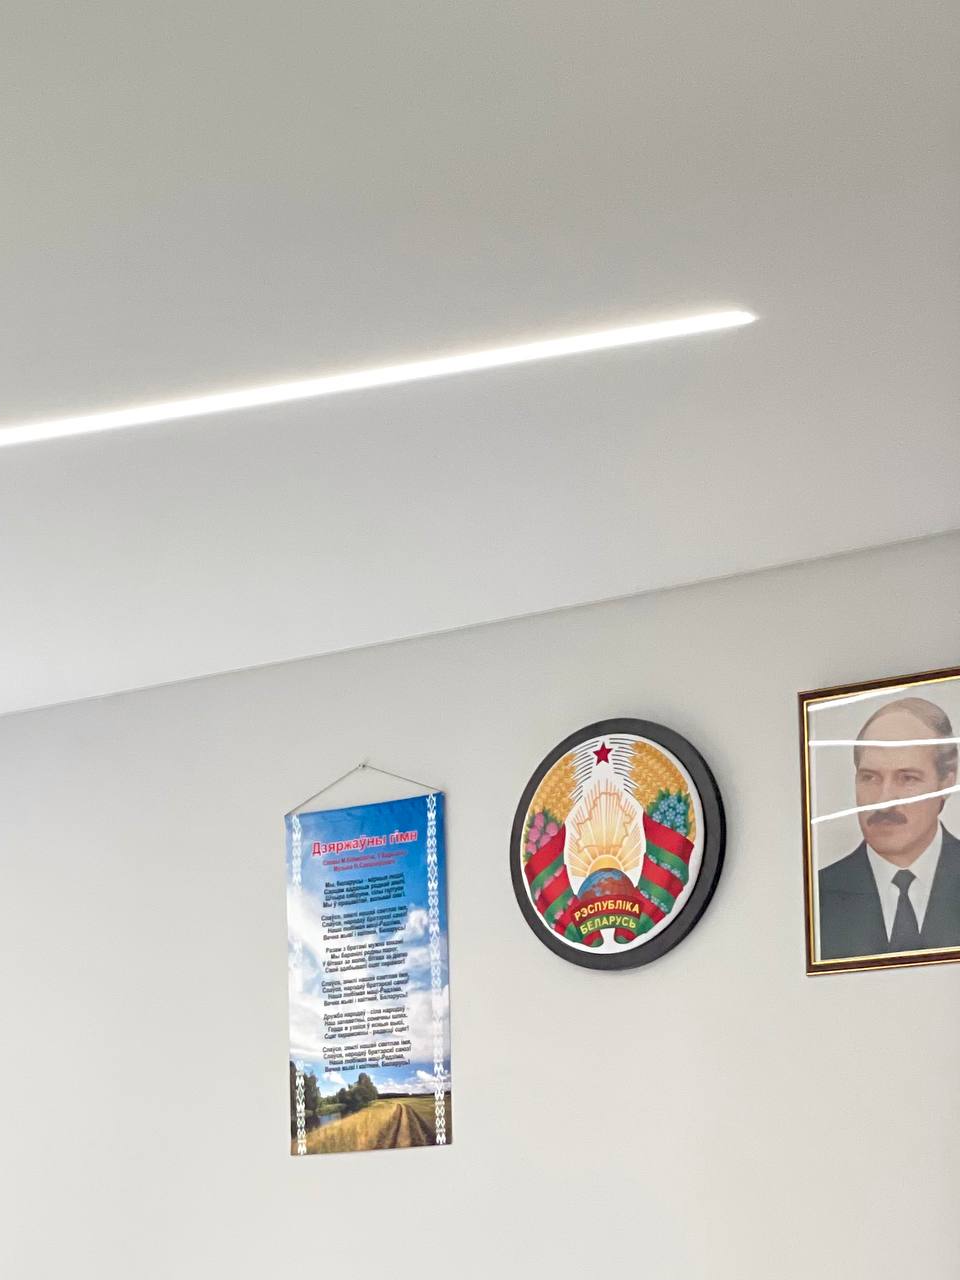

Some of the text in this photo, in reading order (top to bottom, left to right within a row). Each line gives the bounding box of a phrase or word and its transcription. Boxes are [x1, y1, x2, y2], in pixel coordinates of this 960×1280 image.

[312, 830, 418, 856] Дзяржаўны гімн
[574, 900, 640, 921] РЭСПУБЛІКА
[580, 916, 636, 935] БЕЛАРУСЬ
